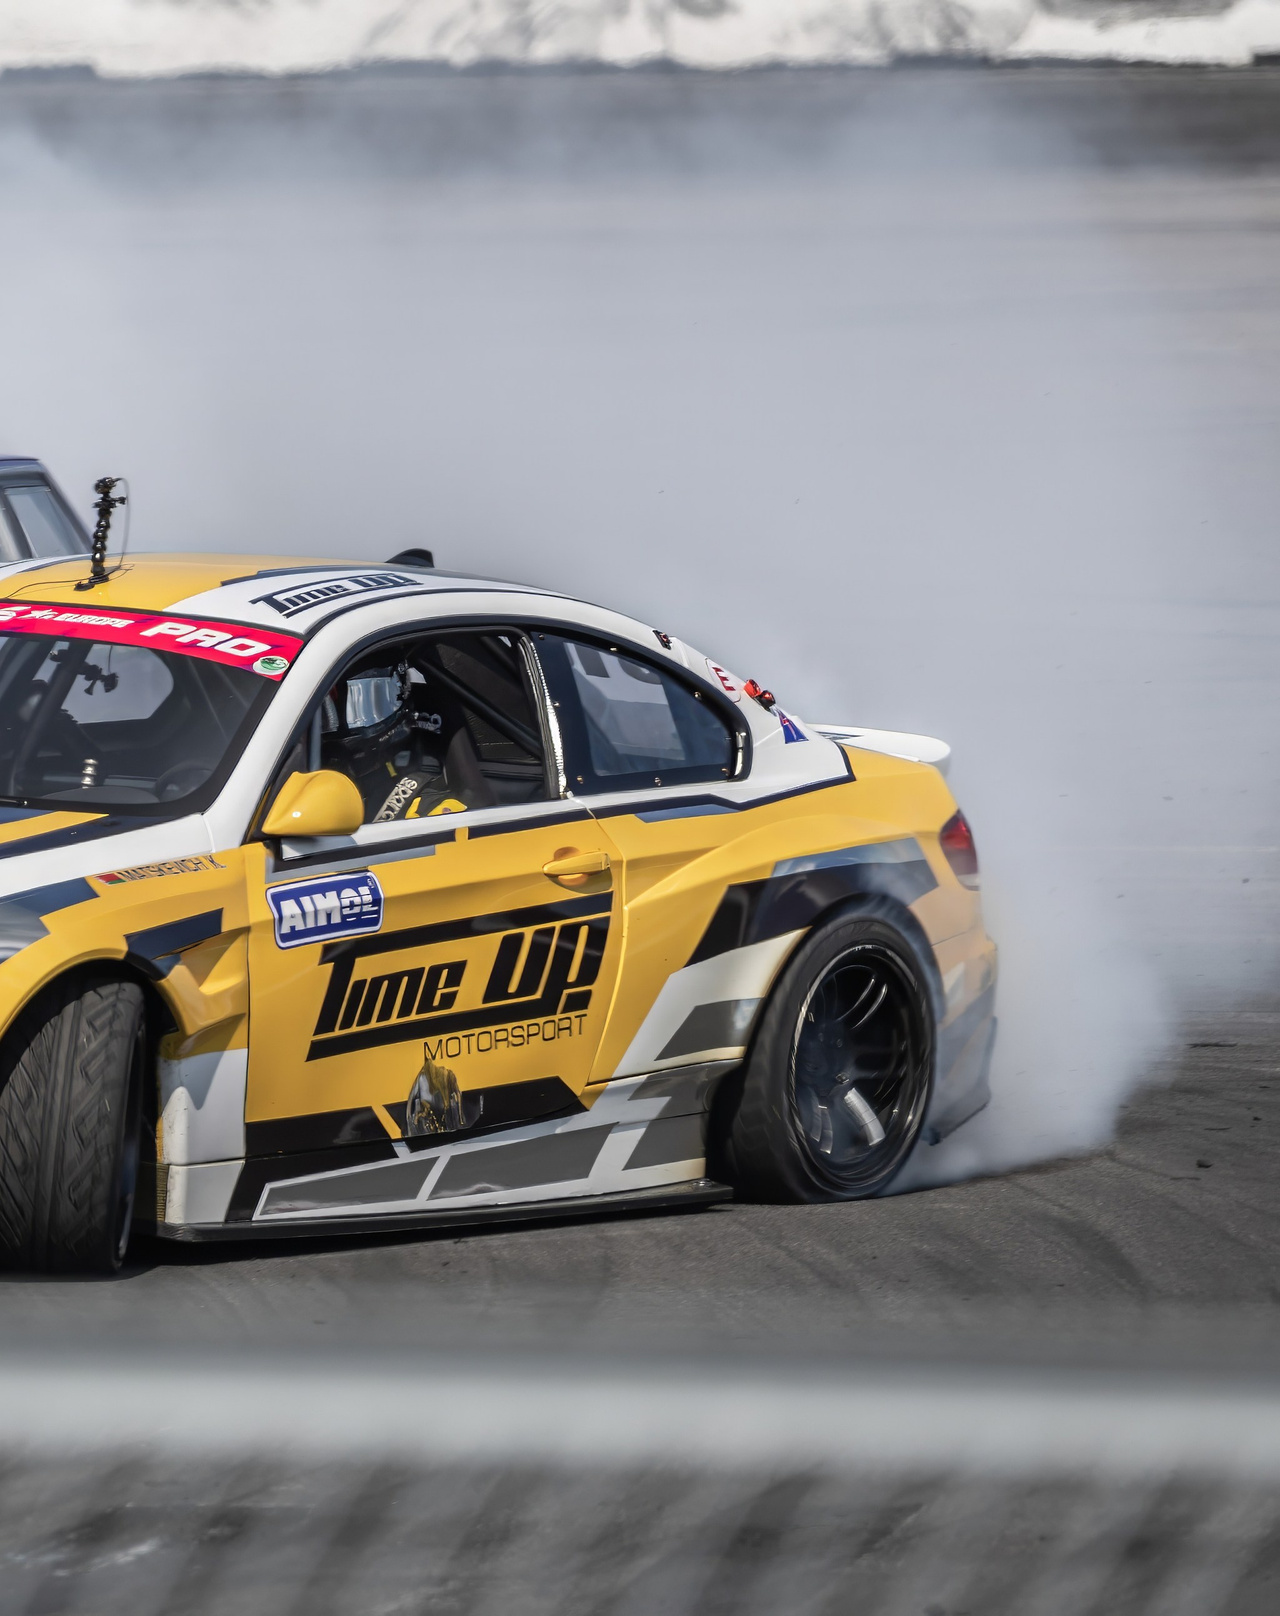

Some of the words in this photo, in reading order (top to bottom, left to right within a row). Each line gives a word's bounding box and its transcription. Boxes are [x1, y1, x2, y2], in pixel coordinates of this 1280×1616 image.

[53, 613, 135, 628] EUROPE
[139, 622, 272, 657] PRO
[279, 886, 377, 934] AIMOL
[423, 1013, 588, 1061] MOTORSPORT
